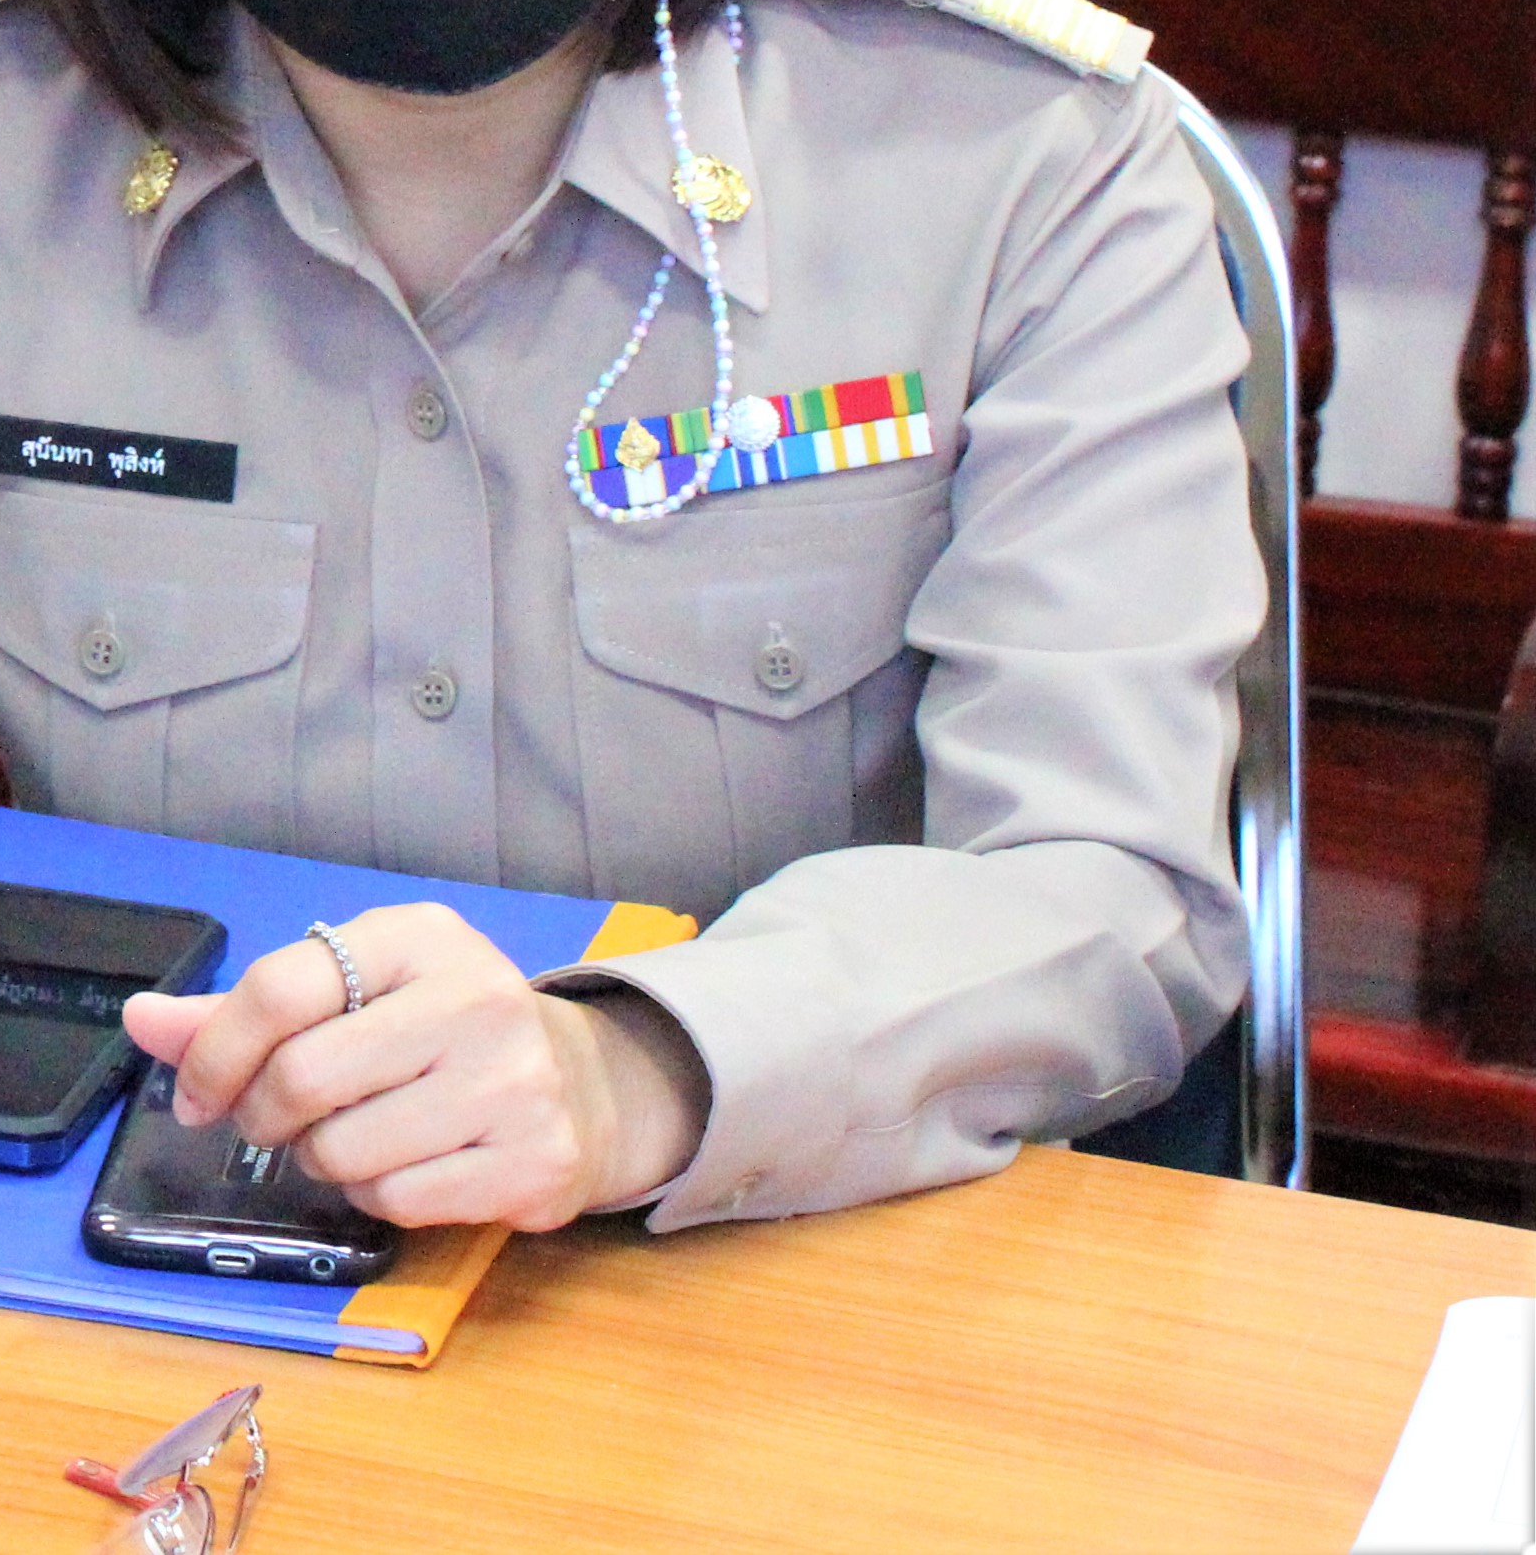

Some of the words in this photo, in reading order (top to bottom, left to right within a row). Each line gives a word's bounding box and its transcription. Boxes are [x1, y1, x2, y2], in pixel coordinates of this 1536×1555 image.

[21, 436, 94, 467] สุนันทา
[107, 446, 167, 479] พุสิงห์
